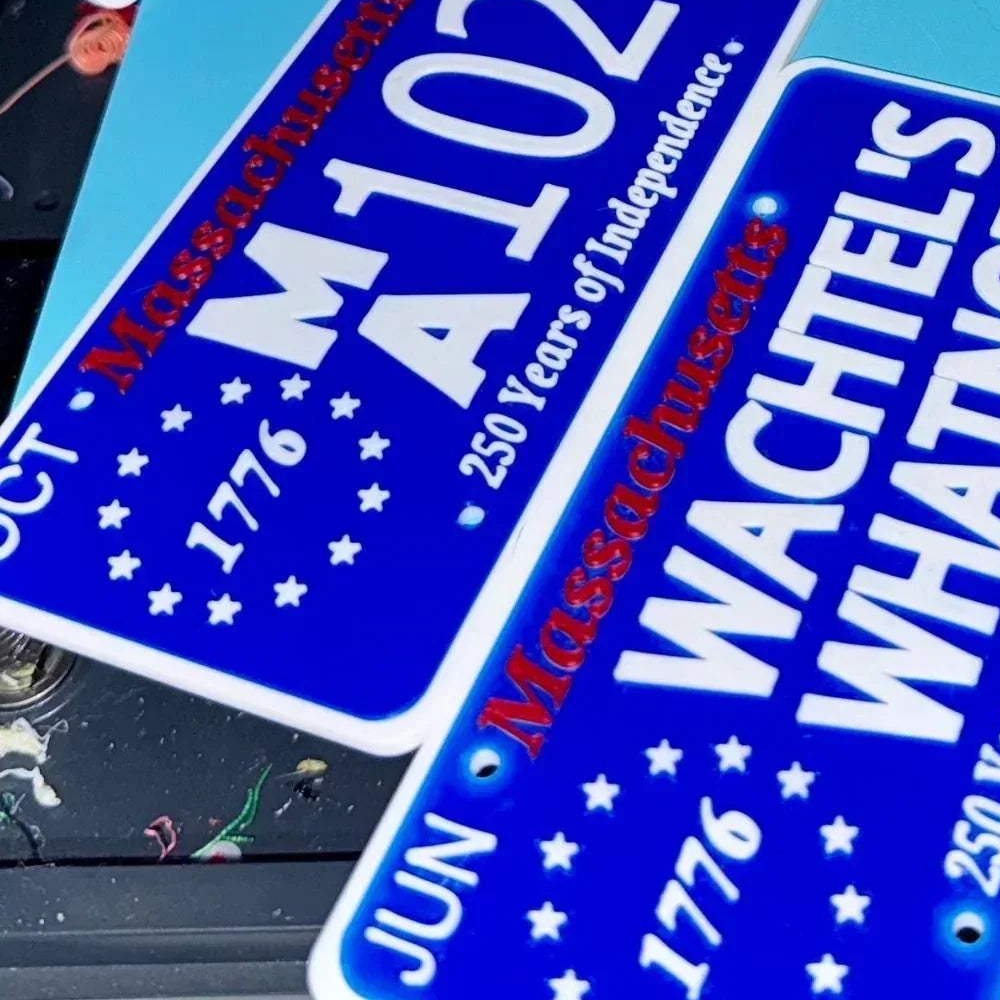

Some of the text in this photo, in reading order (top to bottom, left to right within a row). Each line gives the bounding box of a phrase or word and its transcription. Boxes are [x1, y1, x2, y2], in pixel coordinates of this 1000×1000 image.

[458, 52, 733, 490] 250 Years of Independence
[0, 421, 79, 563] CT
[185, 417, 308, 575] 1776
[476, 215, 789, 761] Massachusetts
[612, 100, 998, 698] WACHTEL'S
[364, 812, 497, 987] JUN
[639, 795, 762, 1000] 1776
